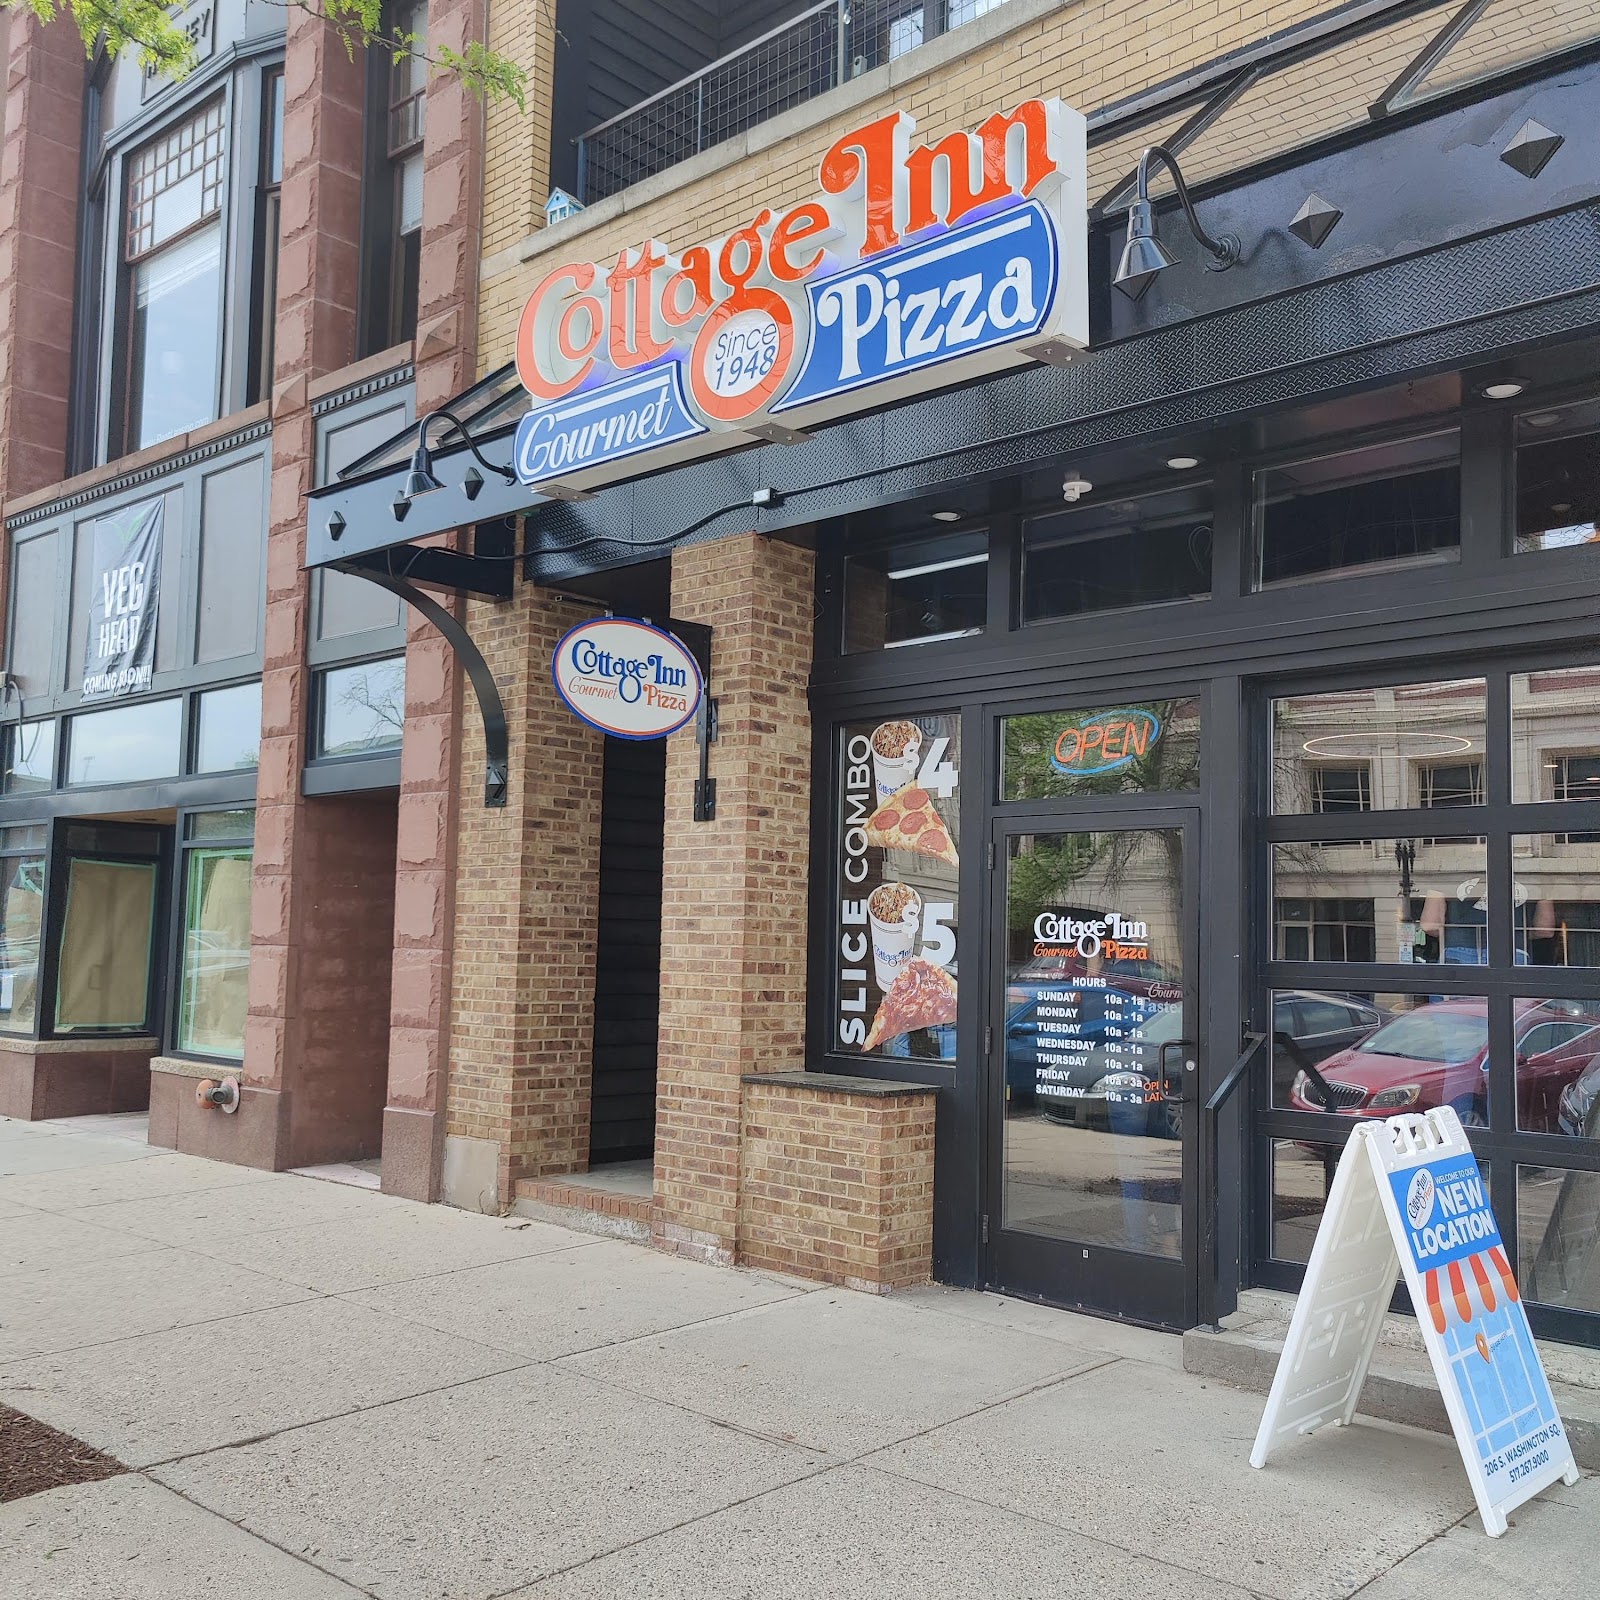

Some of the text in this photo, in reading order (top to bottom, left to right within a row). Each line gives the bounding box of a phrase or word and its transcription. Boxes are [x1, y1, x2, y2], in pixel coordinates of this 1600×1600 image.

[515, 99, 1058, 420] Cottage Inn
[715, 322, 776, 361] Since
[520, 256, 1038, 476] Gourmet Pizza
[715, 345, 776, 390] 1948
[103, 561, 145, 618] VEG
[98, 615, 141, 659] HEAD
[83, 672, 117, 695] COMING
[572, 639, 687, 703] Cottage Inn
[568, 676, 687, 712] Gourmet Pizza
[1055, 720, 1149, 763] OPEN
[840, 735, 871, 1046] SLICE COMBO
[1033, 940, 1148, 960] Gourmet Pizza
[1034, 912, 1148, 958] Cottage Inn
[1037, 992, 1076, 1002] SUNDAY
[1104, 994, 1122, 1005] 10a
[1131, 996, 1143, 1005] 1a
[1072, 976, 1107, 987] HOURS
[1037, 1007, 1078, 1018] MONDAY
[1104, 1010, 1121, 1021] 10a
[1131, 1012, 1143, 1022] 1a
[1037, 1022, 1081, 1034] TUESDAY
[1104, 1026, 1121, 1037] 10a
[1131, 1028, 1143, 1038] 1a
[1037, 1038, 1096, 1051] WEDNESDAY
[1104, 1043, 1121, 1053] 10a
[1131, 1044, 1143, 1055] 1a
[1037, 1053, 1088, 1066] THURSDAY
[1104, 1059, 1122, 1069] 10a
[1131, 1061, 1143, 1071] 1a
[1036, 1069, 1070, 1080] FRIDAY
[1104, 1075, 1122, 1086] 10a
[1130, 1077, 1142, 1087] 3a
[1036, 1084, 1085, 1097] SATURDAY
[1104, 1091, 1122, 1101] 10a
[1130, 1093, 1142, 1104] 3a
[1435, 1167, 1475, 1184] WELCOME TO OUR
[1436, 1176, 1484, 1218] NEW
[1411, 1208, 1496, 1259] LOCATION
[1484, 1459, 1498, 1476] 206
[1505, 1429, 1550, 1463] WASHINGTON
[1548, 1423, 1561, 1437] SQ.
[1509, 1449, 1549, 1483] 517.267.9000
